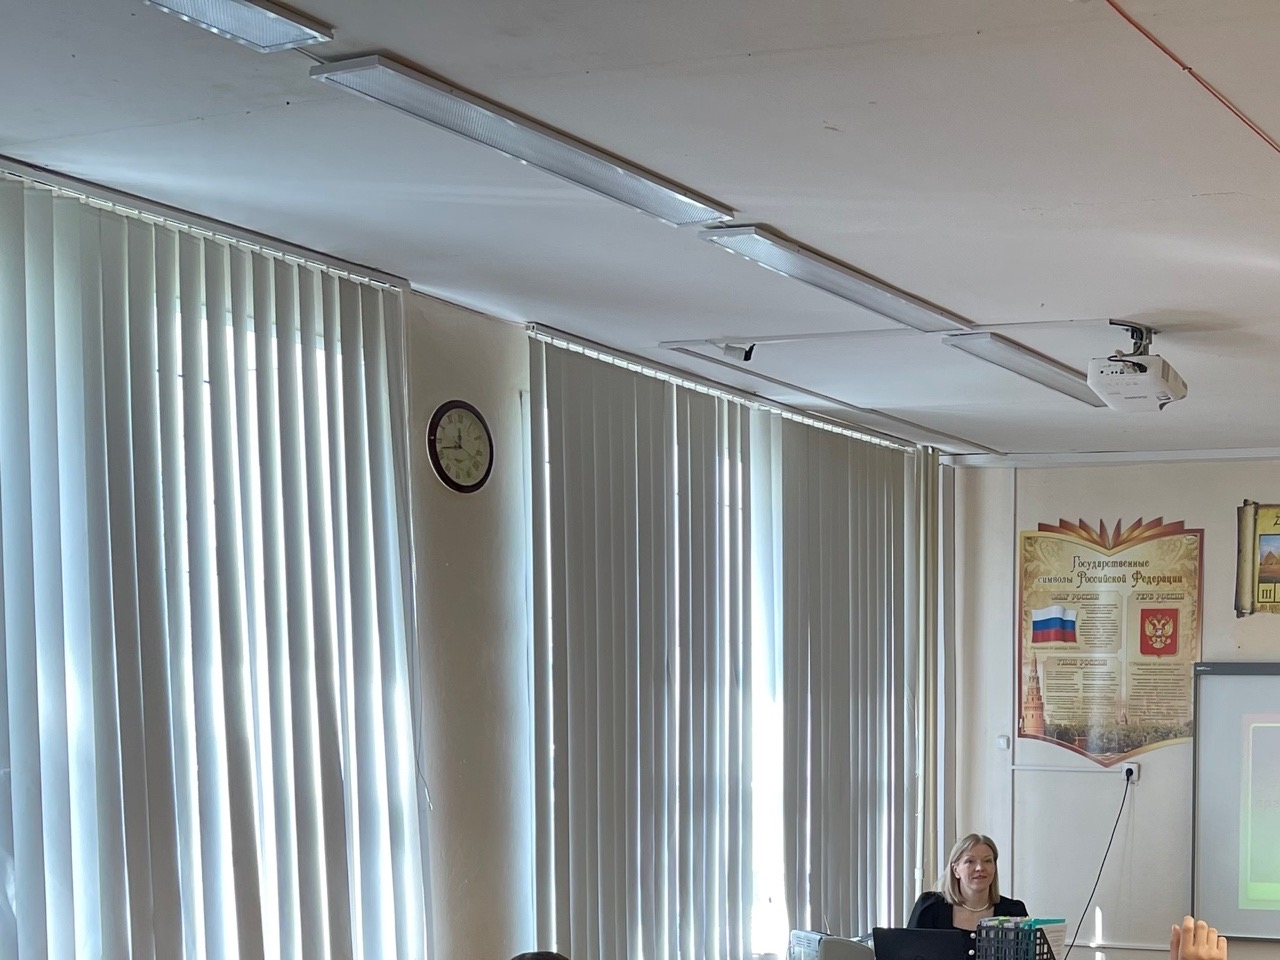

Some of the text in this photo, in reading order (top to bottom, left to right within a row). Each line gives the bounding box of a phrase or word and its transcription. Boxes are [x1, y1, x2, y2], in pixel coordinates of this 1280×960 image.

[1070, 556, 1149, 572] Государственные
[1076, 570, 1127, 588] Российской
[1131, 570, 1183, 588] Федерации
[1261, 589, 1272, 600] III
